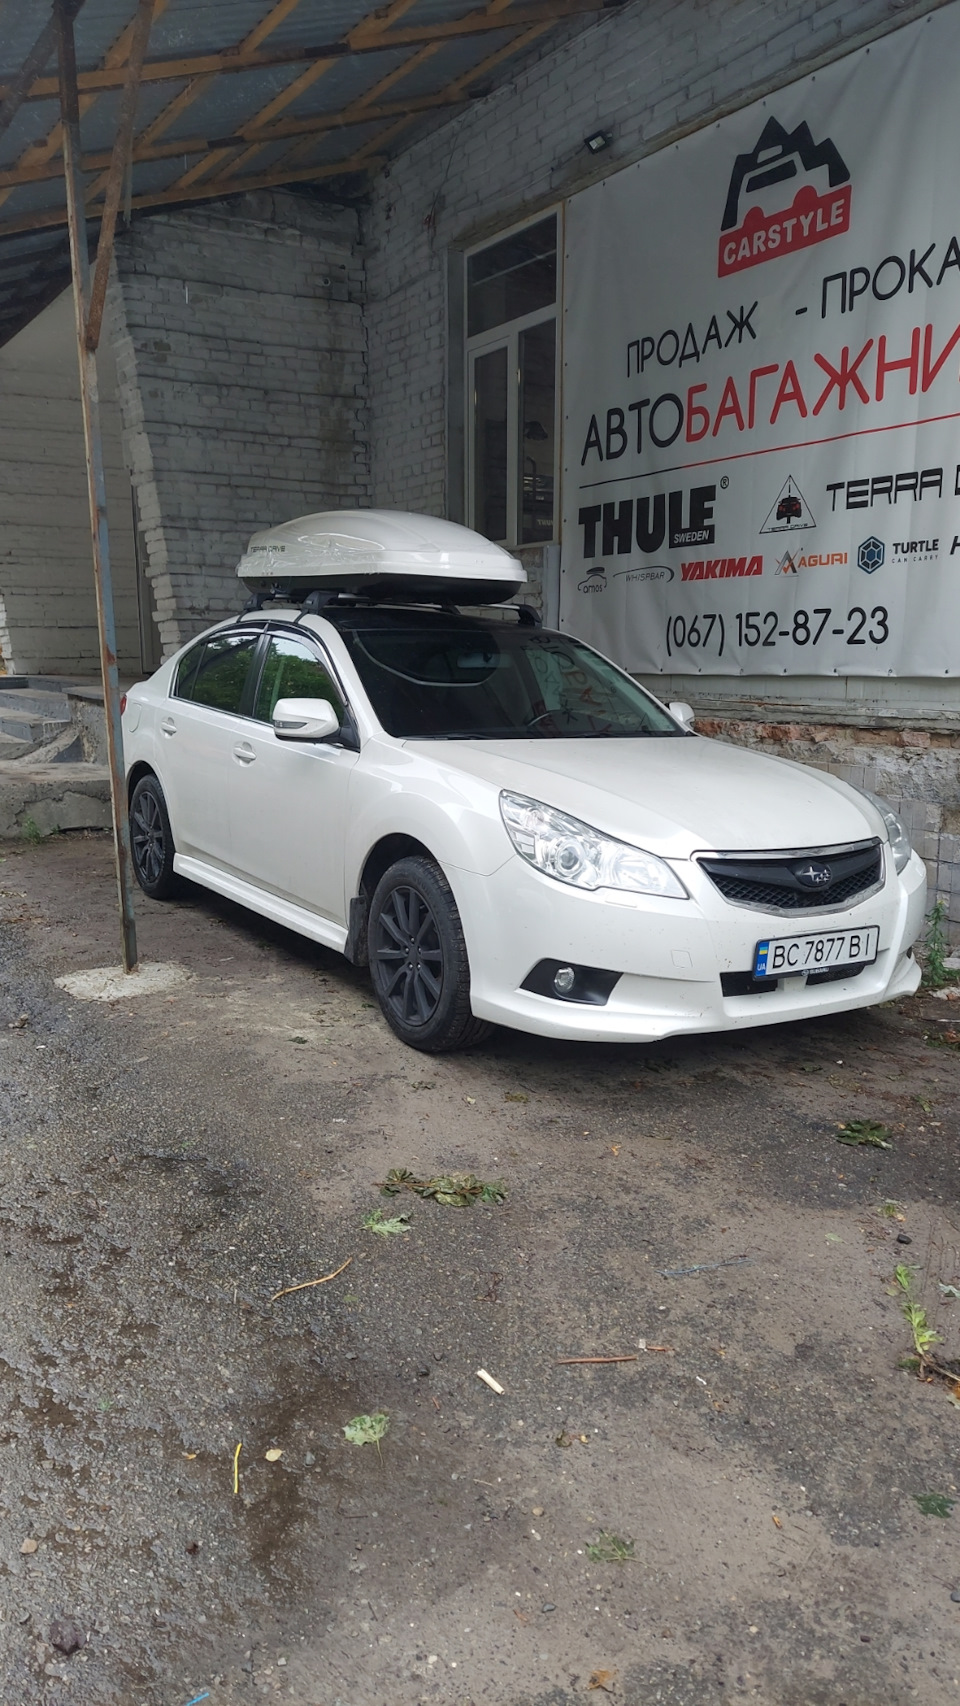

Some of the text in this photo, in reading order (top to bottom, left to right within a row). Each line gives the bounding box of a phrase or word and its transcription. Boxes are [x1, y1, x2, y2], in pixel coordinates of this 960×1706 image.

[723, 199, 845, 266] CARSTYLE
[626, 300, 759, 378] ПРОДАЖ
[821, 236, 960, 318] ПРОКА
[826, 467, 943, 511] TERRA
[578, 485, 717, 559] THULE
[673, 529, 710, 544] SWEDEN
[892, 538, 939, 555] TURTLE
[681, 555, 763, 582] YAKIMA
[798, 552, 848, 569] AGURI
[583, 584, 603, 594] amos
[625, 571, 665, 582] WHISPBAR
[666, 606, 889, 657] (067) 152-87-23
[772, 933, 870, 969] BC 7877 BI
[757, 963, 766, 971] UA
